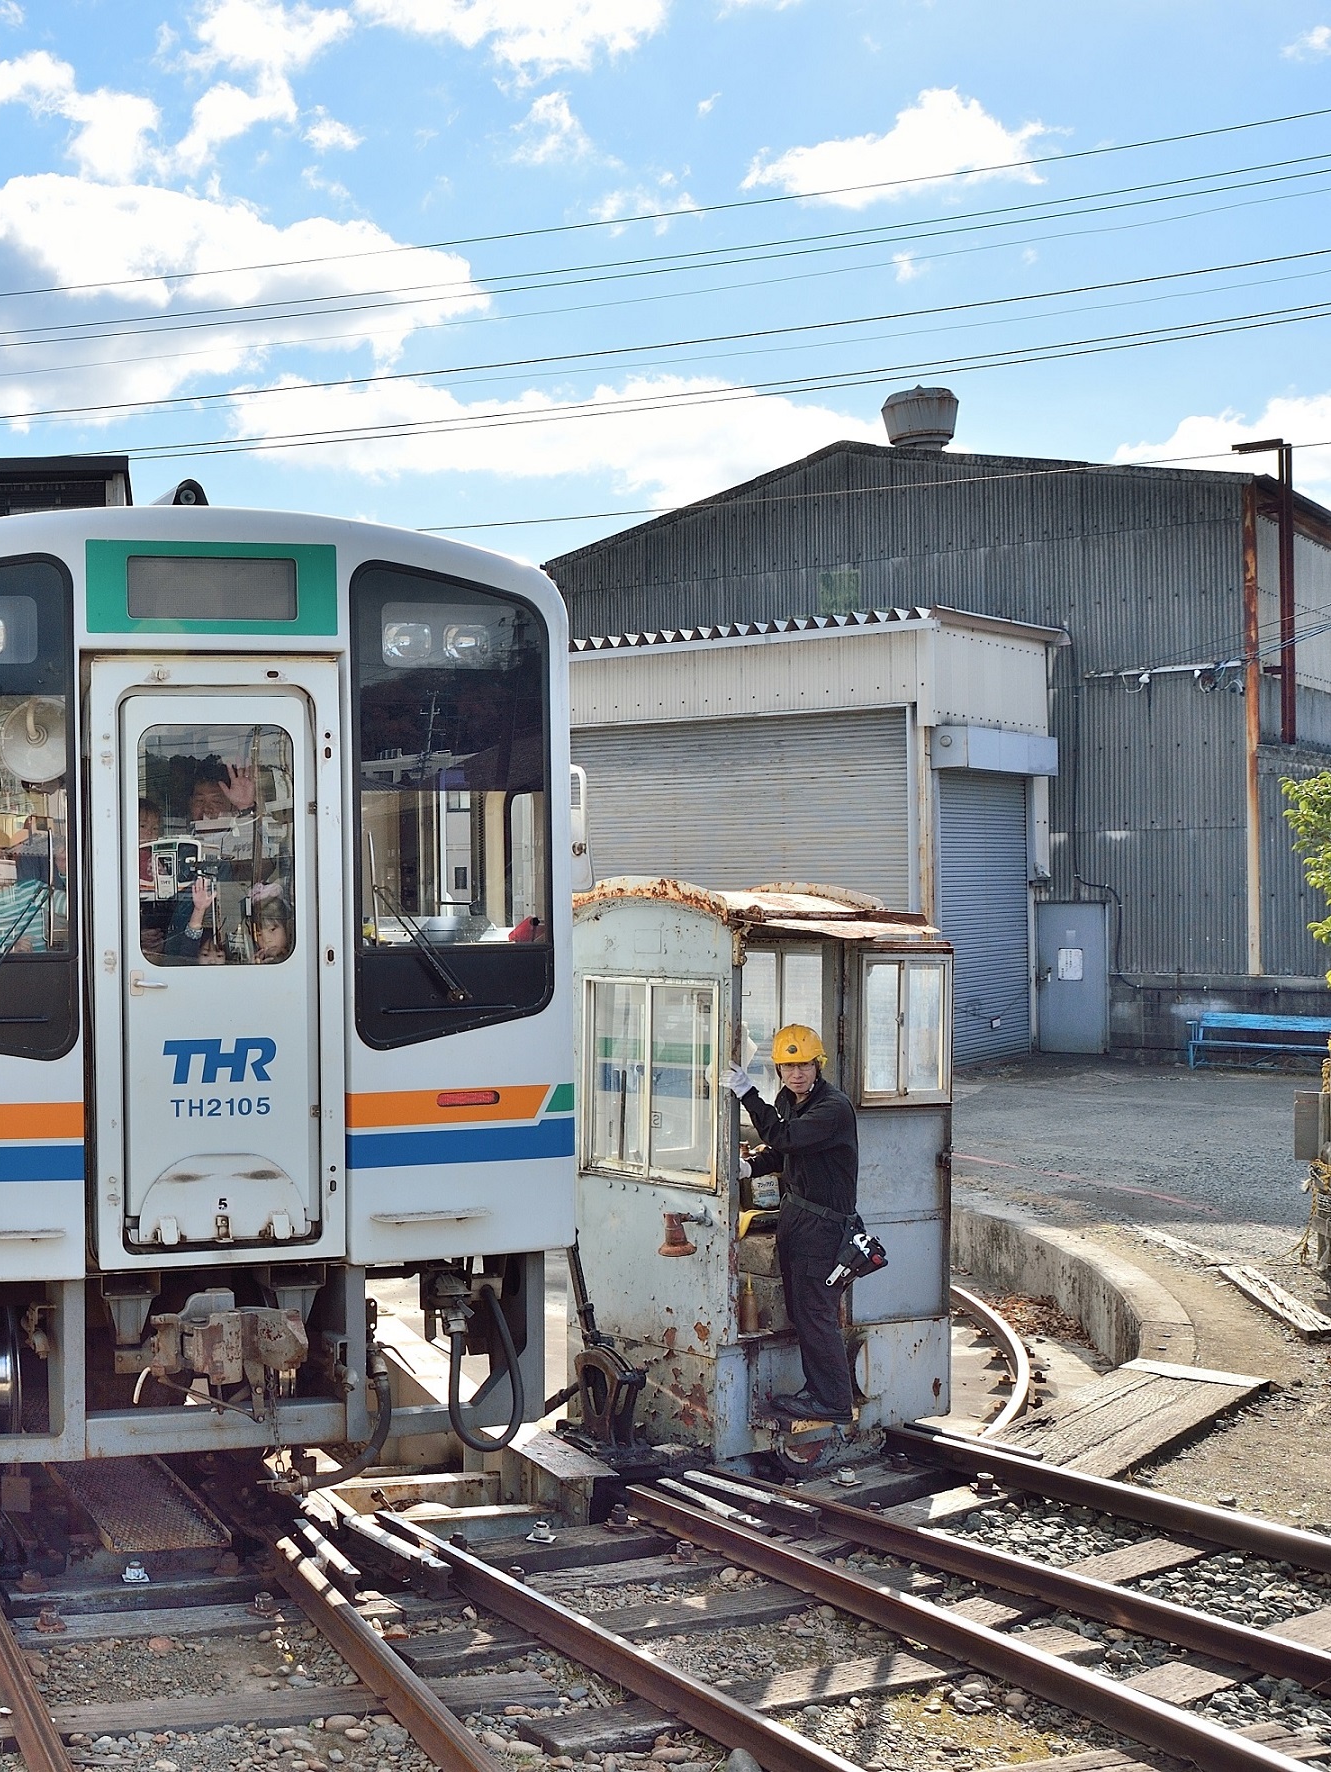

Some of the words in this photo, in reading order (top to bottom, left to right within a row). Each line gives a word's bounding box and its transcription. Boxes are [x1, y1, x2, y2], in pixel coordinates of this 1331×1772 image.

[163, 1037, 277, 1085] THR
[170, 1096, 271, 1118] TH2105
[217, 1197, 228, 1211] 5
